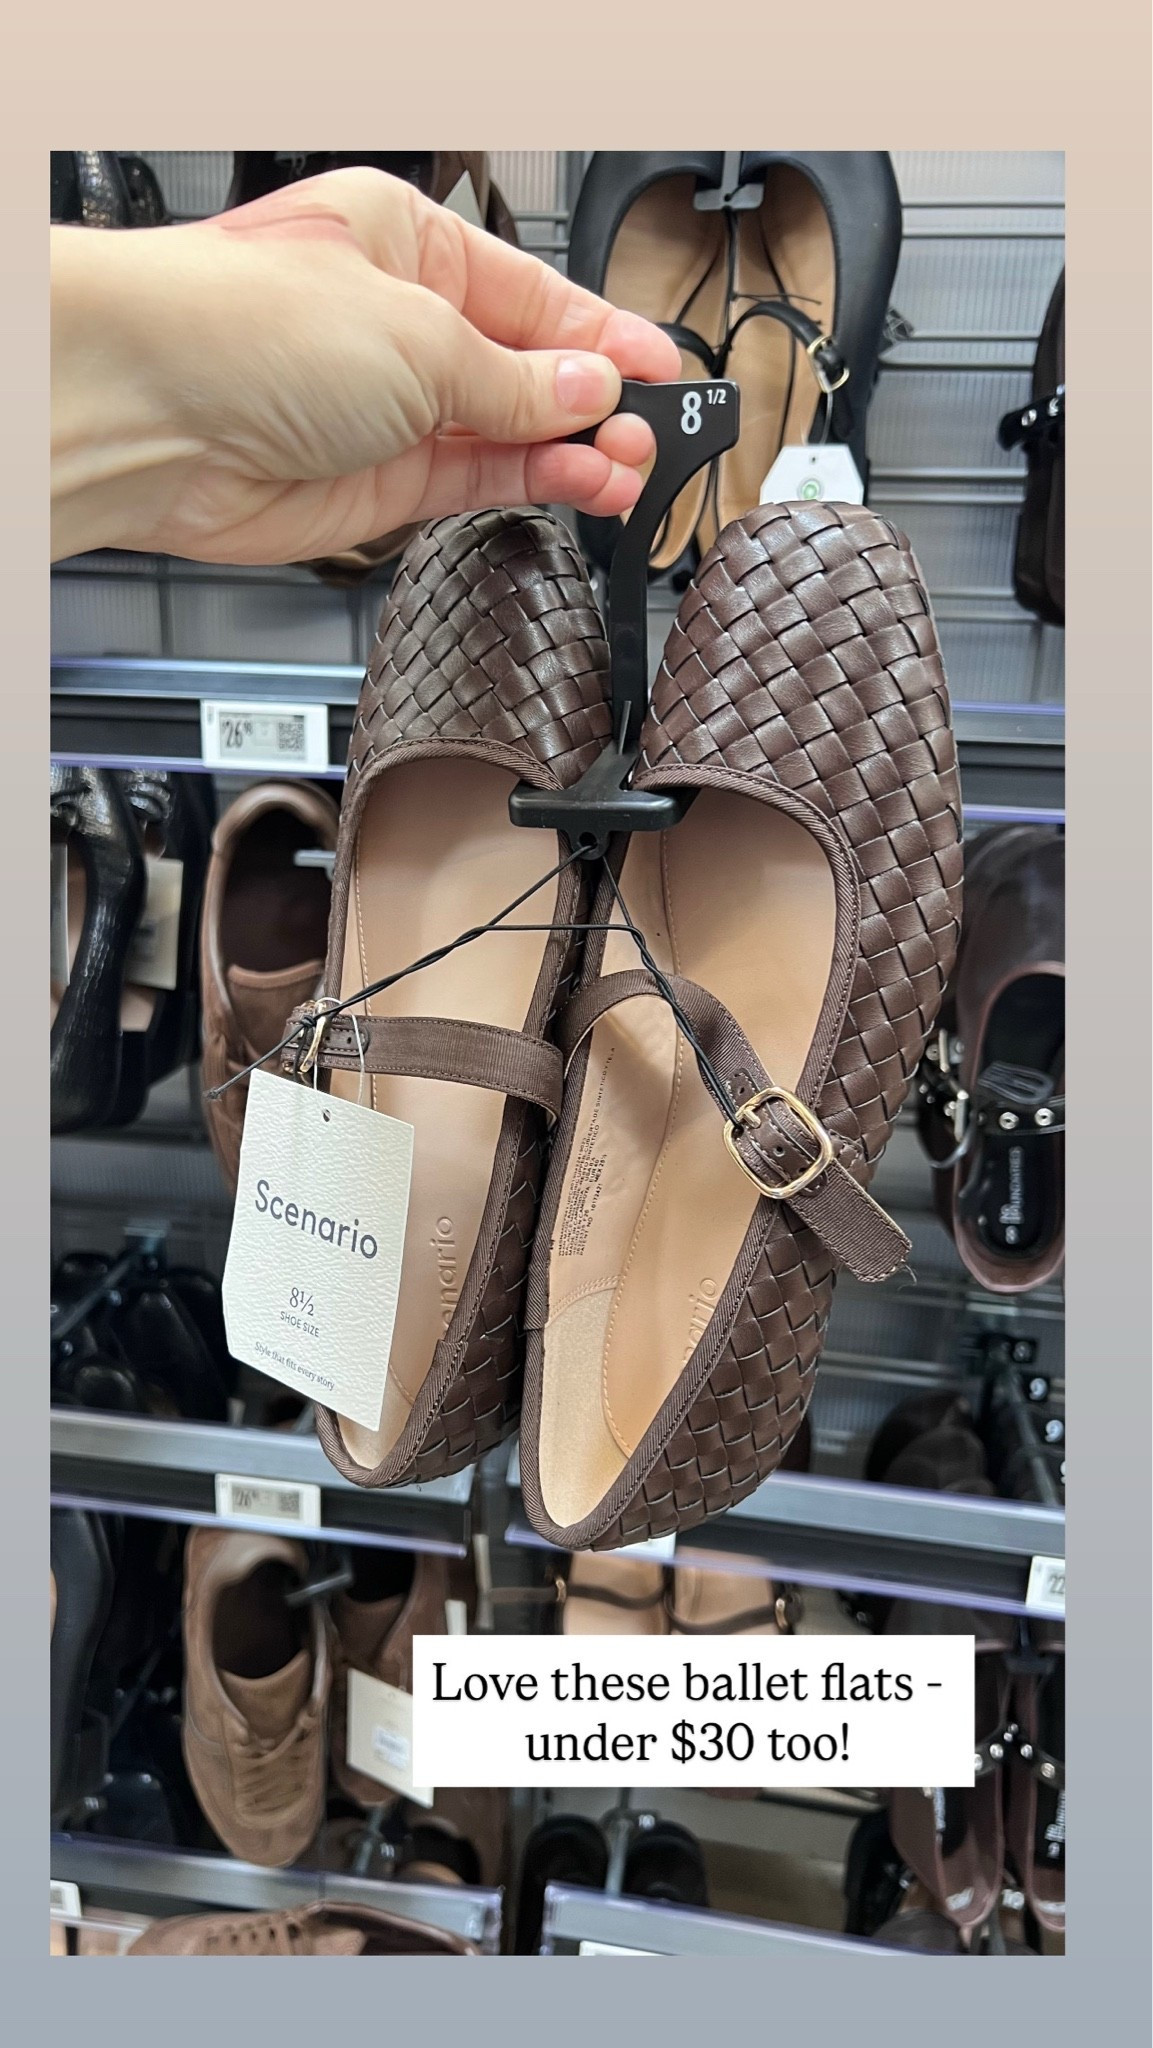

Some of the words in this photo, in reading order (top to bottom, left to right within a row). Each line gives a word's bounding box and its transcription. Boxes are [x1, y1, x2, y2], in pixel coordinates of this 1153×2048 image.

[681, 391, 702, 435] 8
[255, 1179, 378, 1259] Scenario
[280, 1311, 301, 1329] SHOE
[303, 1322, 320, 1338] SIZE
[255, 1341, 271, 1358] Style
[272, 1350, 285, 1364] that
[286, 1357, 297, 1371] fits
[297, 1365, 316, 1382] every
[316, 1374, 335, 1391] story
